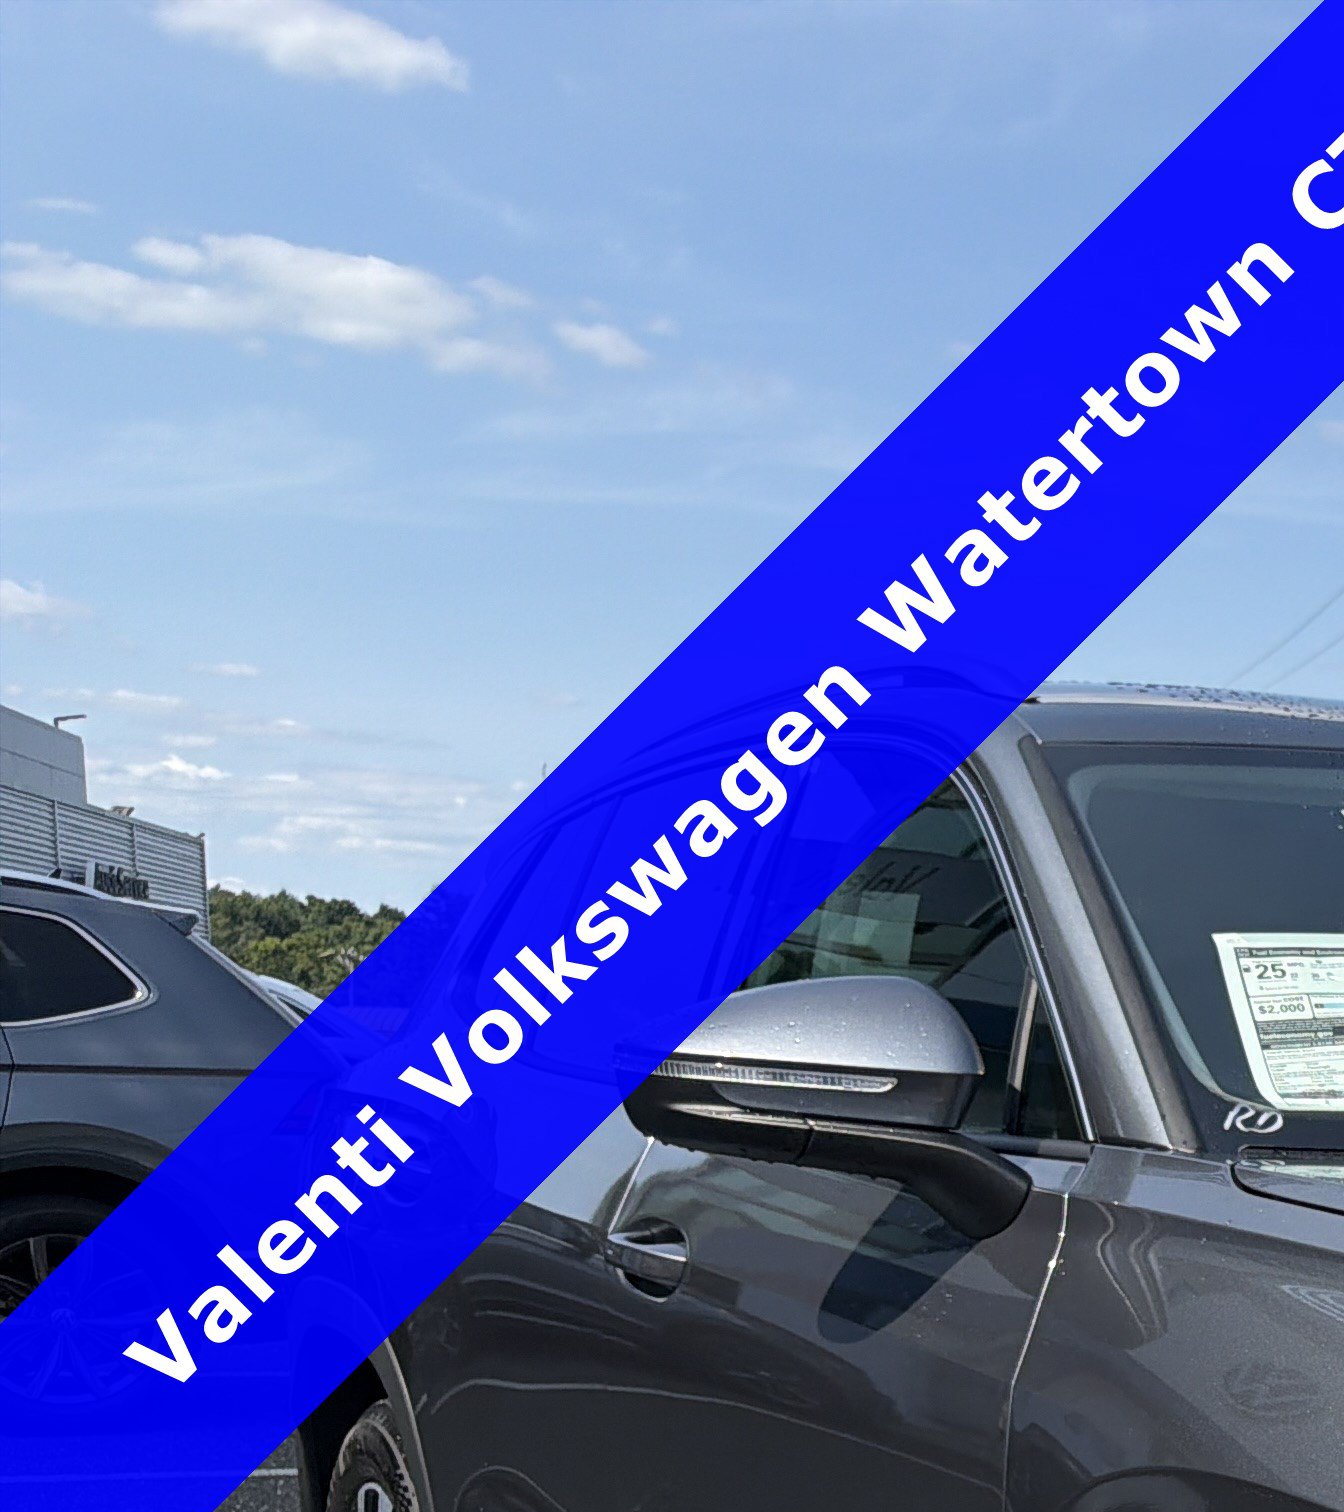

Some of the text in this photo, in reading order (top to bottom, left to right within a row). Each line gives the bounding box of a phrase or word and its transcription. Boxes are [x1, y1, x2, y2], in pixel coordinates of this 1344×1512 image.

[1255, 963, 1287, 980] 25
[1258, 1002, 1306, 1015] $2,000
[1223, 1103, 1284, 1134] RD
